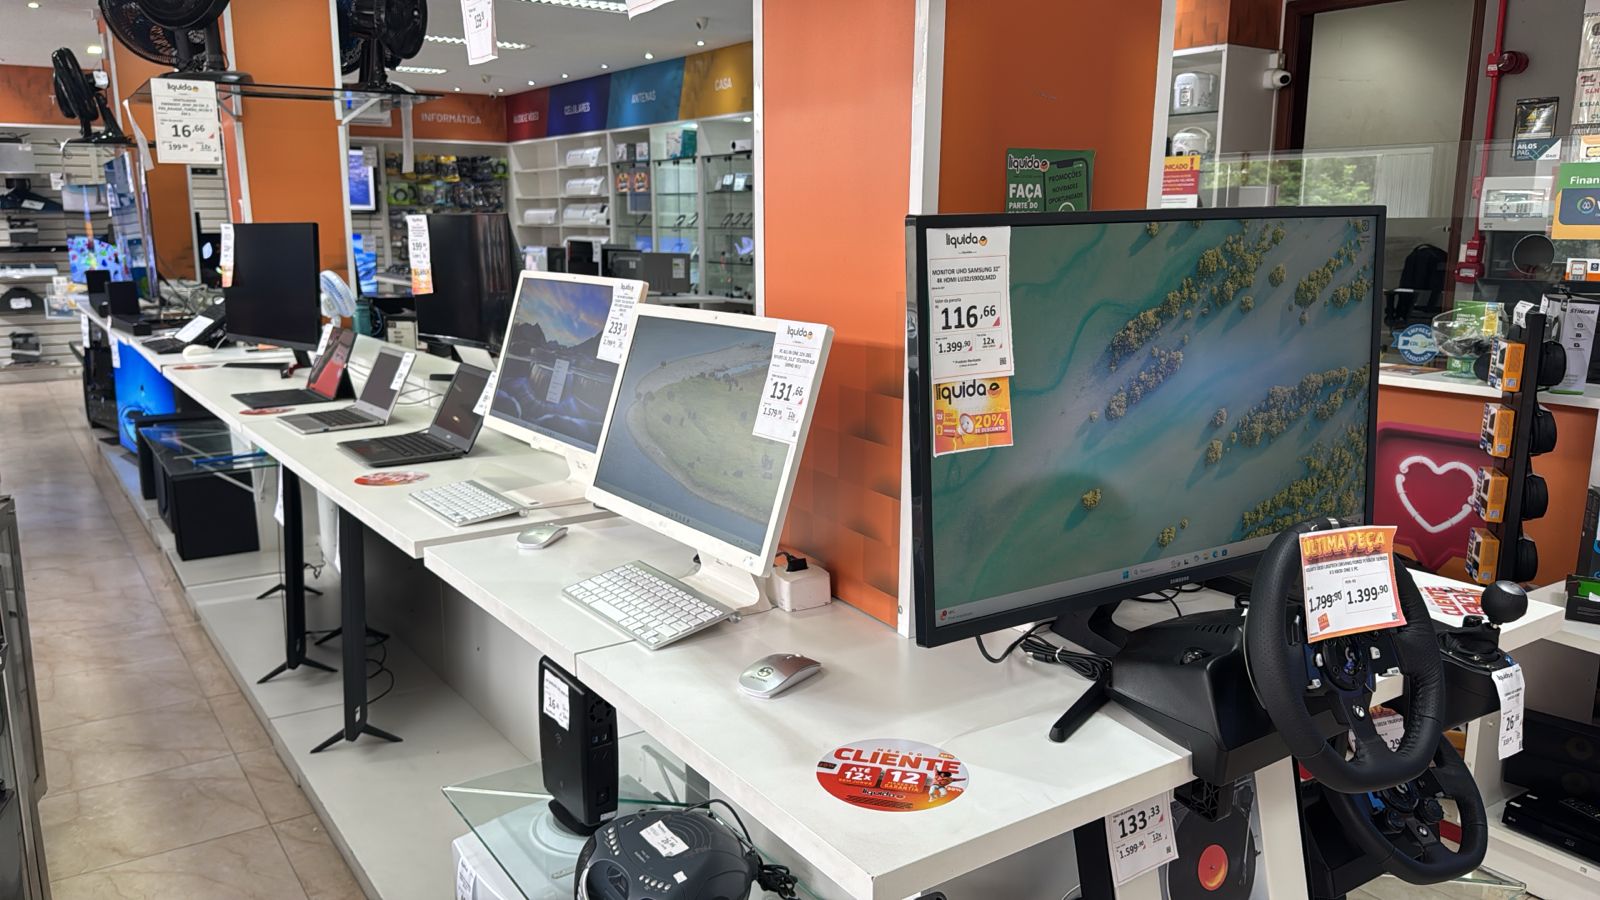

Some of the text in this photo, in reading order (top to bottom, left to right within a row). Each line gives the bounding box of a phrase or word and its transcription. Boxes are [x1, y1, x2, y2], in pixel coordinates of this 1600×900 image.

[715, 77, 733, 91] CASA
[1009, 183, 1043, 202] FAÇA
[945, 232, 979, 248] liquida
[968, 265, 992, 273] SAMSUNG
[1407, 327, 1432, 337] EMPRESA
[982, 337, 996, 345] 12x
[936, 378, 987, 405] liquida
[975, 413, 1005, 428] 20%
[1303, 531, 1385, 557] ÚLTIMA PEÇA
[833, 747, 961, 775] CLIENTE
[844, 771, 872, 782] 12x
[850, 765, 871, 774] ATÉ
[890, 771, 921, 785] 12
[1117, 805, 1160, 839] 133,33
